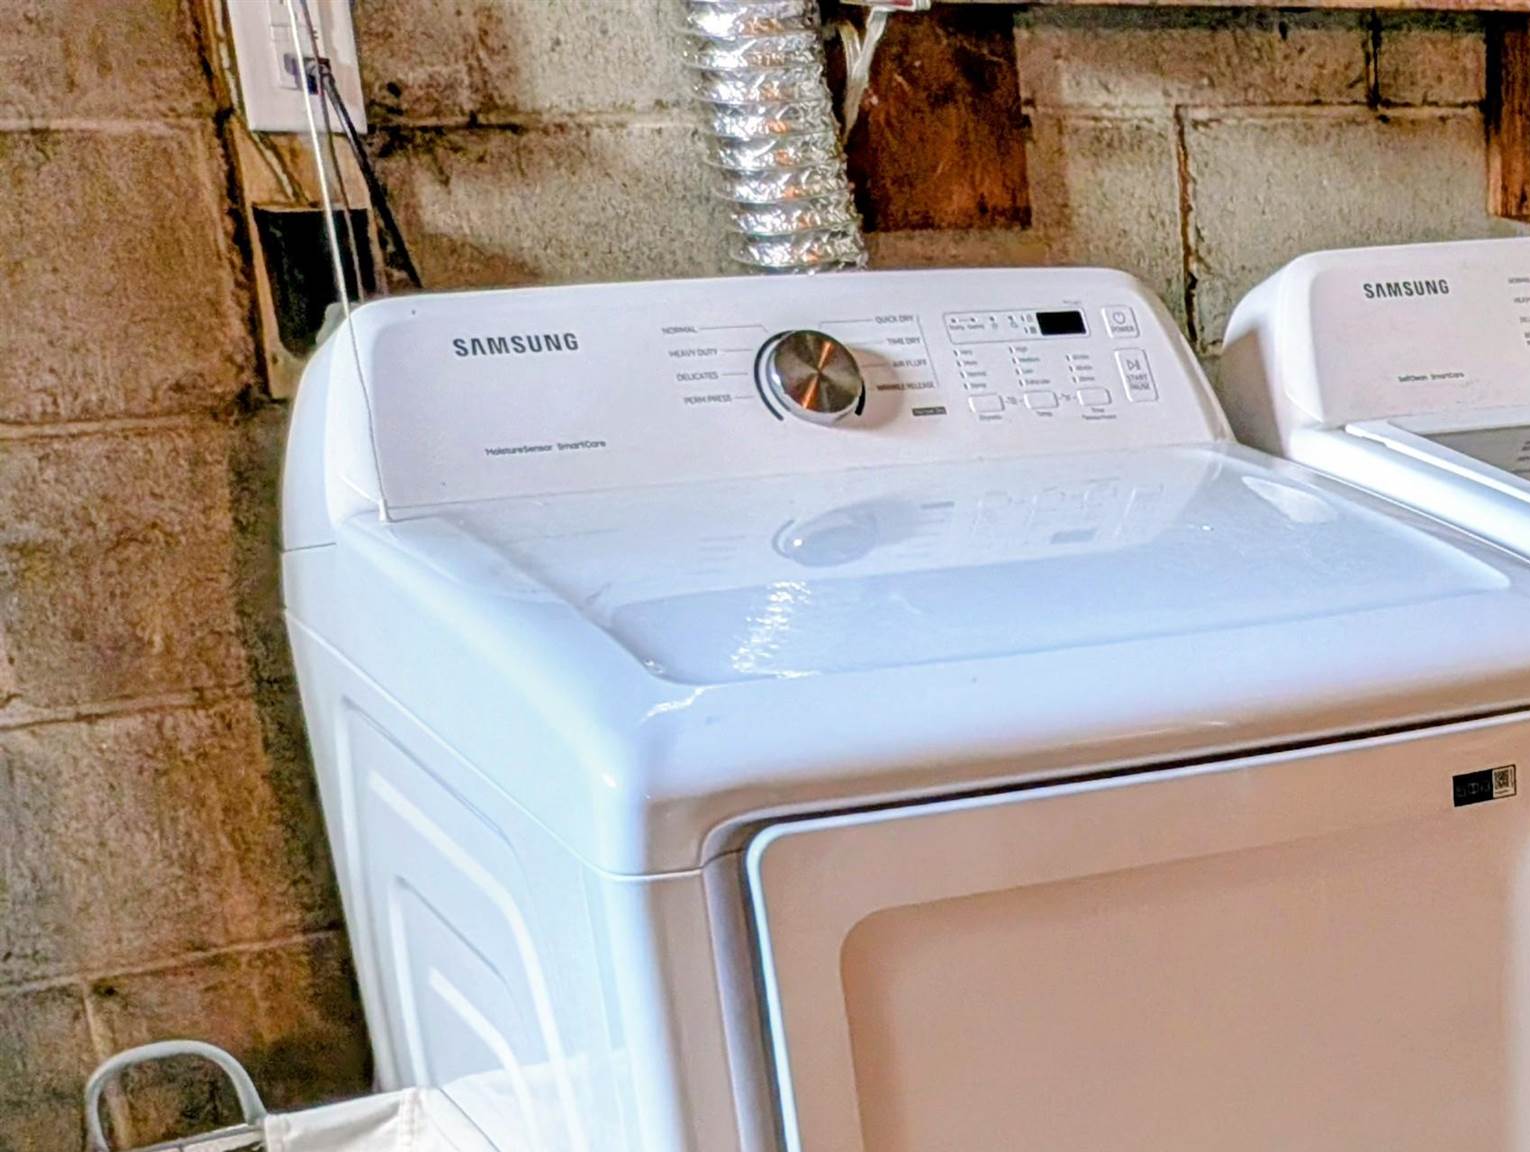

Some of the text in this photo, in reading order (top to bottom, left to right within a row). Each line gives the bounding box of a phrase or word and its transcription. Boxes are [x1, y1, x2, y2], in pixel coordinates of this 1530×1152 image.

[1363, 279, 1449, 299] SAMSUNG
[875, 314, 914, 325] QUICK DRY
[661, 326, 698, 335] NORMAL
[452, 332, 578, 357] SAMSUNG
[886, 336, 921, 346] TIME DRY
[668, 347, 718, 358] HEAVY DUTY
[676, 371, 719, 381] DELICATES
[707, 393, 733, 403] PRESS
